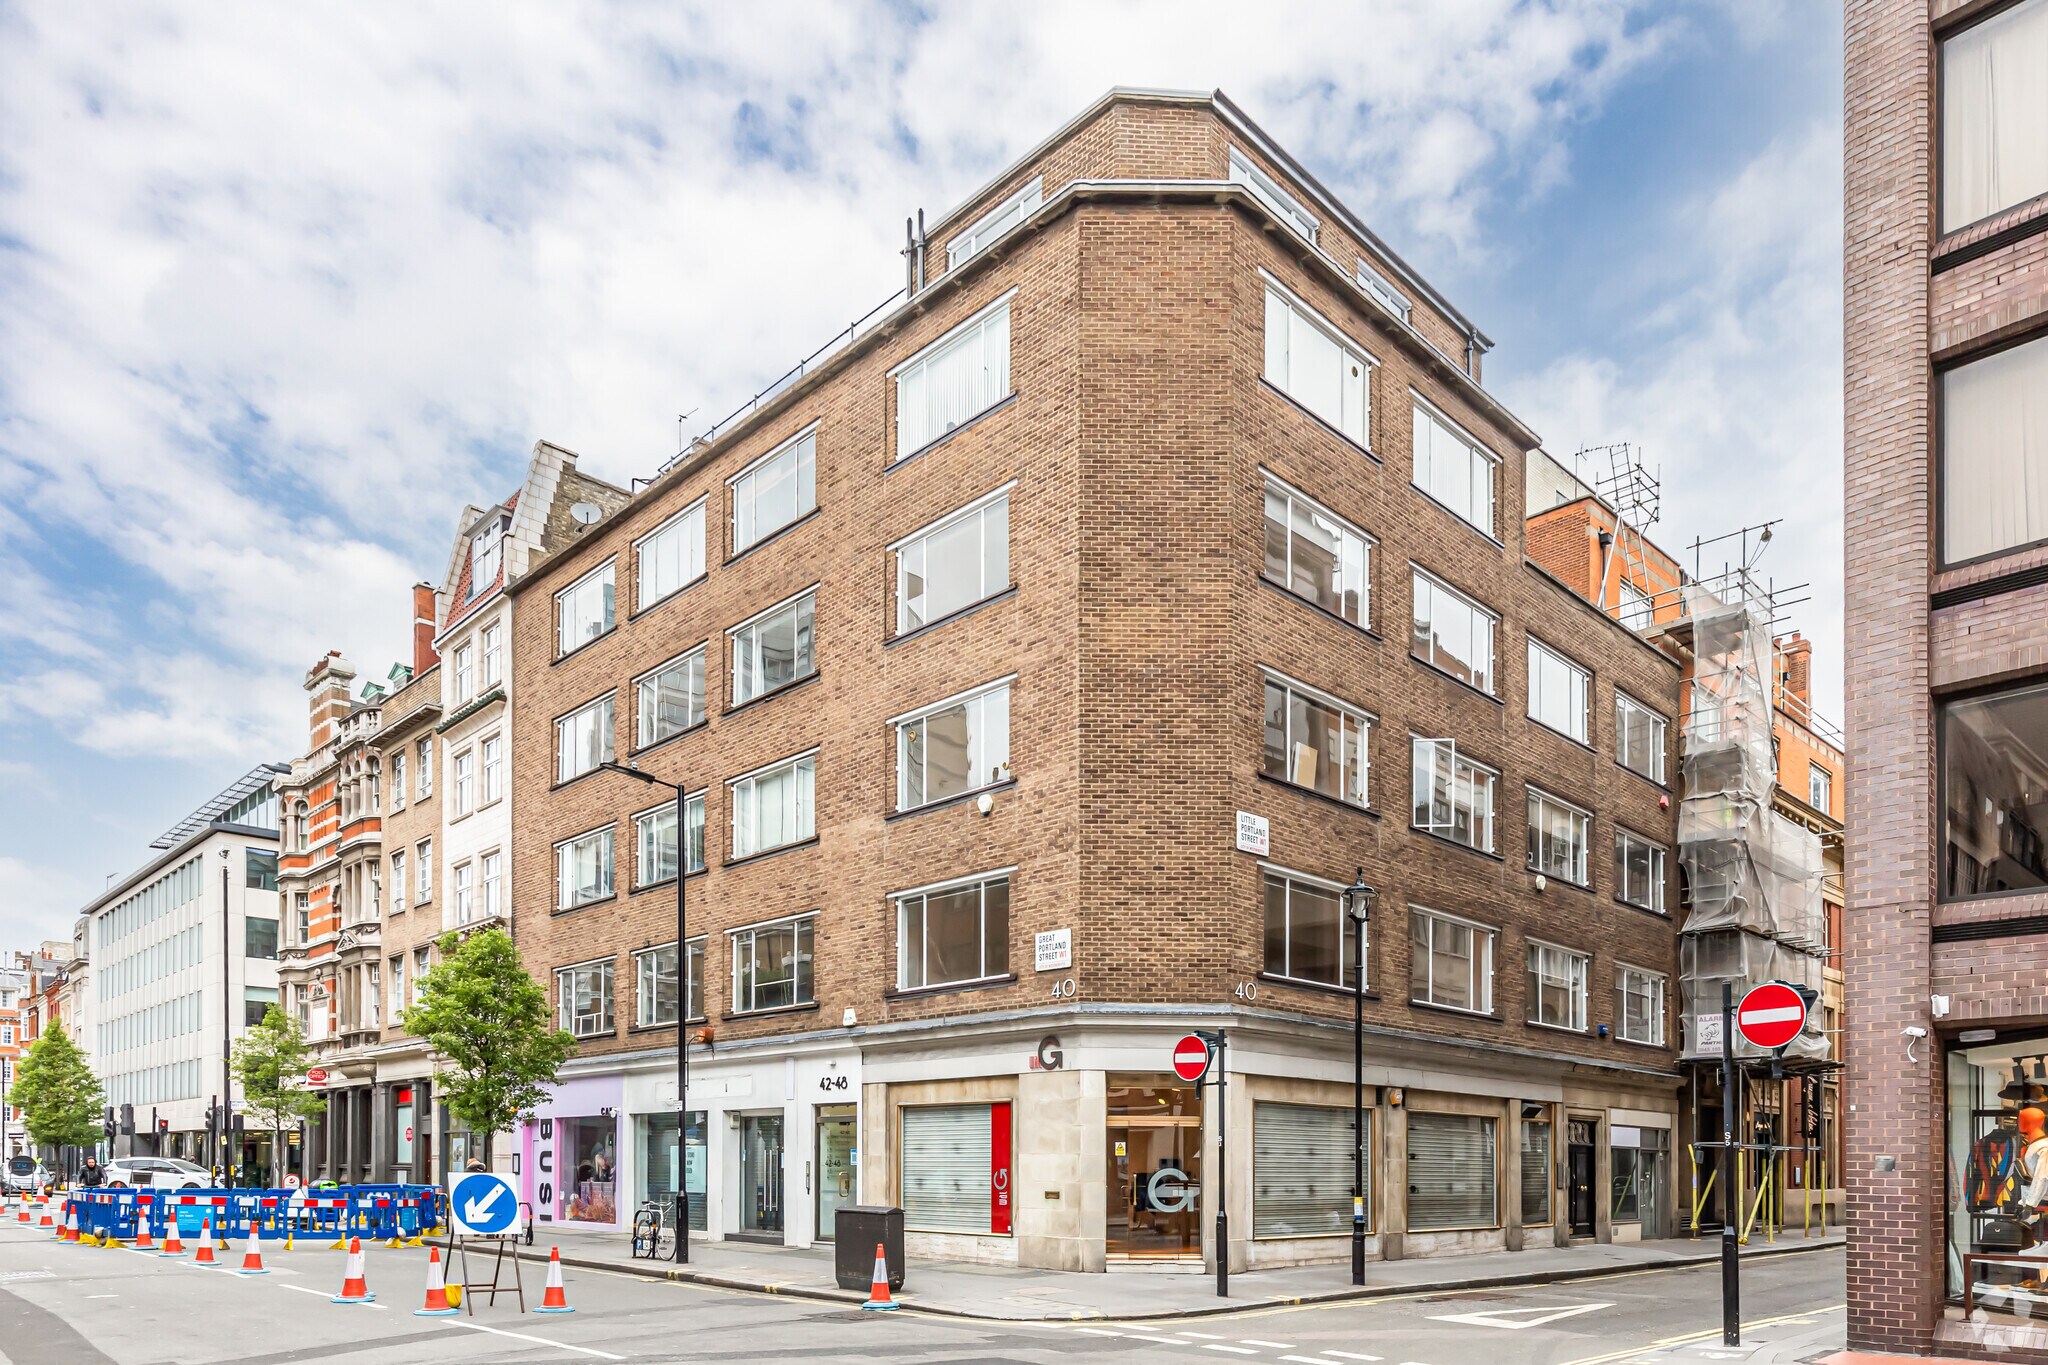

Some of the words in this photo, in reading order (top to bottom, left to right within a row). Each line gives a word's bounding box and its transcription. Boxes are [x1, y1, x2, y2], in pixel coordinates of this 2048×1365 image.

[1241, 815, 1256, 826] LITTLE
[1241, 824, 1266, 837] PORTLAND
[1241, 833, 1259, 844] STREET
[1038, 934, 1055, 944] GREAT
[1038, 941, 1067, 953] PORTLAND
[1038, 952, 1058, 962] STREET
[1051, 978, 1076, 999] 40
[1234, 981, 1257, 1001] 40
[819, 1076, 848, 1091] 42-48
[1147, 1167, 1194, 1213] G
